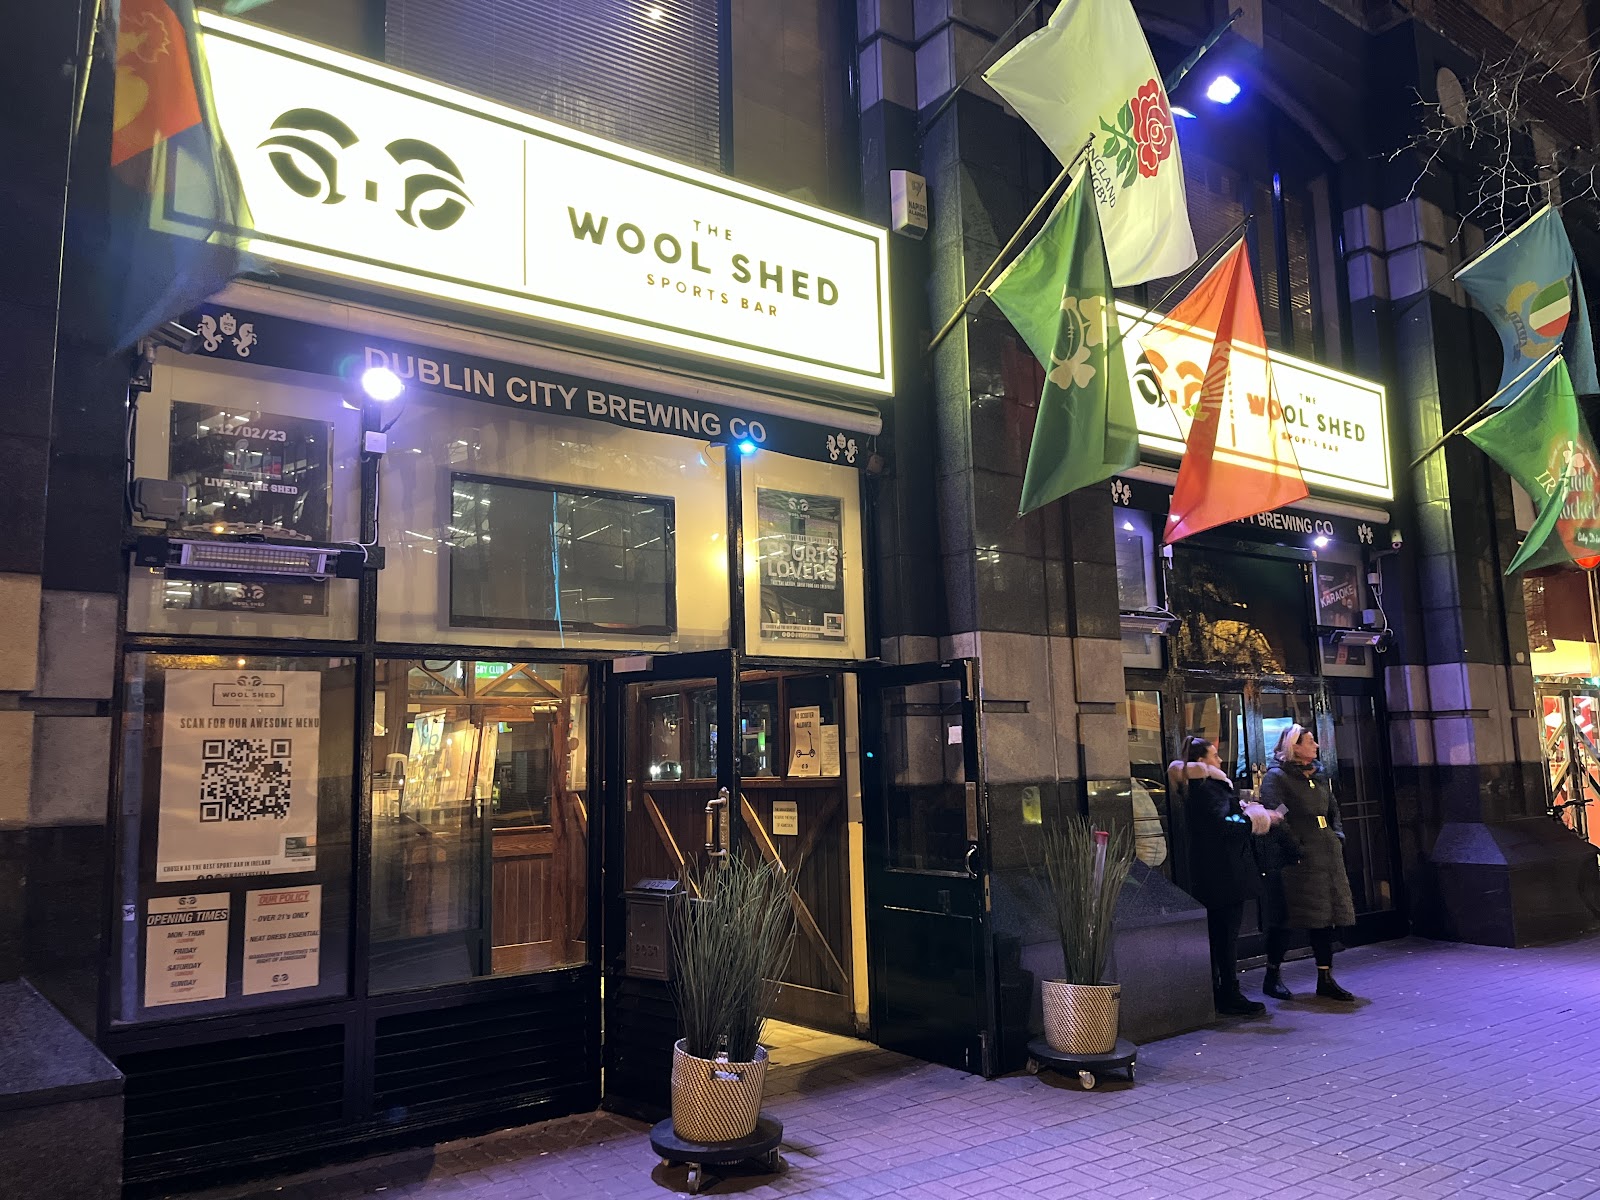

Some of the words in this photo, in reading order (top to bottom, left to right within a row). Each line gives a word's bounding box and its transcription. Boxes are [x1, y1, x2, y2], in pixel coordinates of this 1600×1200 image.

[908, 200, 927, 213] NAPIER
[693, 219, 732, 241] THE
[567, 205, 711, 275] WOOL
[731, 253, 839, 306] SHED
[646, 273, 729, 305] SPORTS
[741, 297, 777, 317] BAR
[364, 346, 495, 398] DUBLIN
[505, 376, 579, 411] CITY
[586, 389, 722, 438] BREWING
[729, 416, 768, 444] CO
[1300, 393, 1316, 405] THE
[1247, 392, 1309, 428] WOOL
[1317, 413, 1365, 442] SHED
[218, 422, 287, 442] 12/02/23
[204, 476, 231, 488] LIVE
[248, 481, 269, 492] THE
[270, 484, 298, 495] SHED
[1257, 511, 1312, 534] BREWING
[1315, 519, 1334, 536] CO
[767, 557, 837, 582] LOVERS
[1320, 584, 1354, 608] KARAOKE
[489, 665, 505, 674] CLUB
[180, 717, 205, 729] SCAN
[207, 717, 226, 729] FOR
[228, 717, 247, 729] OUR
[250, 717, 293, 729] AWESOME
[295, 717, 320, 728] MENU
[279, 891, 309, 903] POLICY
[146, 912, 194, 926] OPENING
[196, 909, 229, 921] TIMES
[258, 914, 277, 922] OVER
[266, 932, 287, 940] DRESS
[287, 929, 320, 939] ESSENTIAL
[167, 962, 202, 971] SATURDAY
[170, 979, 198, 987] SUNDAY
